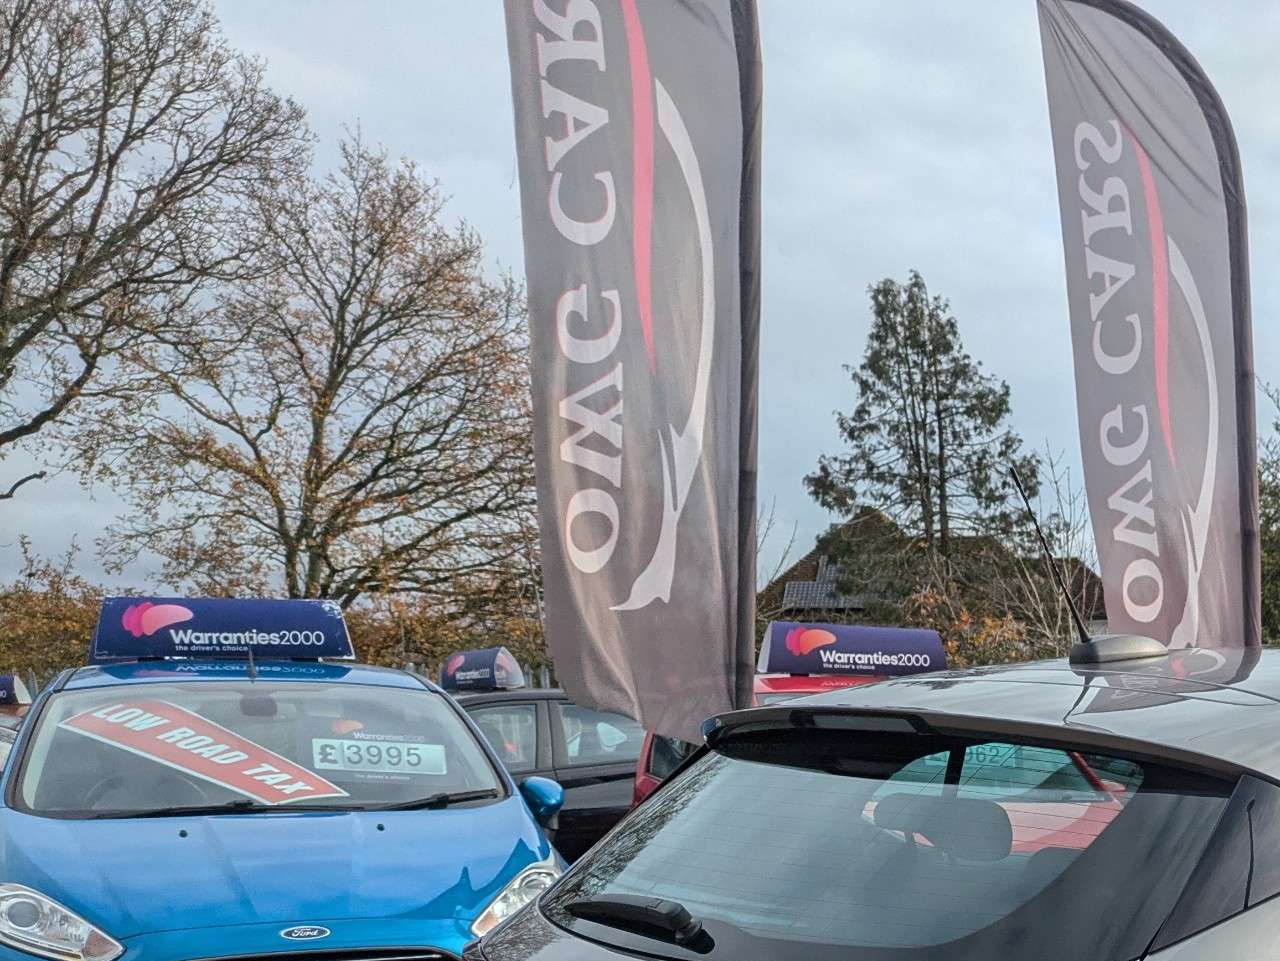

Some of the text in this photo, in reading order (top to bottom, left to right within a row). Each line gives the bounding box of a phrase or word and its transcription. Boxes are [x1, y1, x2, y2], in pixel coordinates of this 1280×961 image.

[169, 628, 325, 646] Warranties2000
[819, 649, 931, 667] Warranties2000
[92, 704, 315, 794] LOW ROAD TAX
